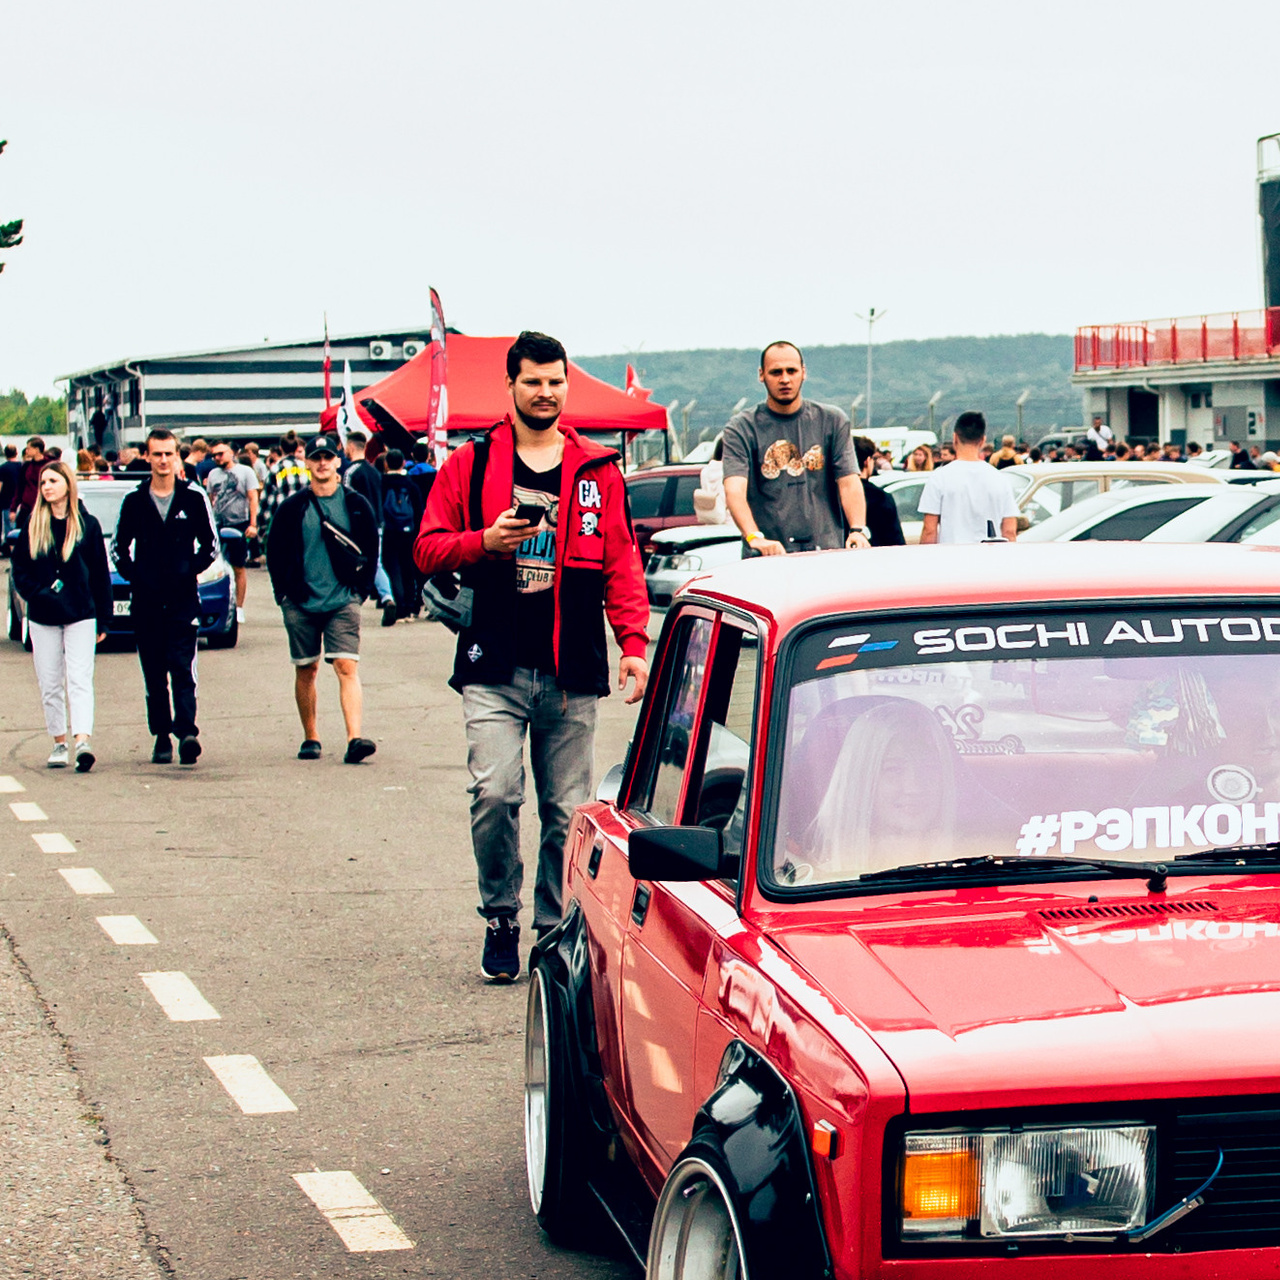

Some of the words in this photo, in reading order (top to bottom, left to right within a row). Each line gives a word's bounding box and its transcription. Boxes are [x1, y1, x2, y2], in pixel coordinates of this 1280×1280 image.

[1248, 412, 1256, 435] 2
[526, 570, 549, 583] CLUB
[916, 622, 1089, 655] SOCHI
